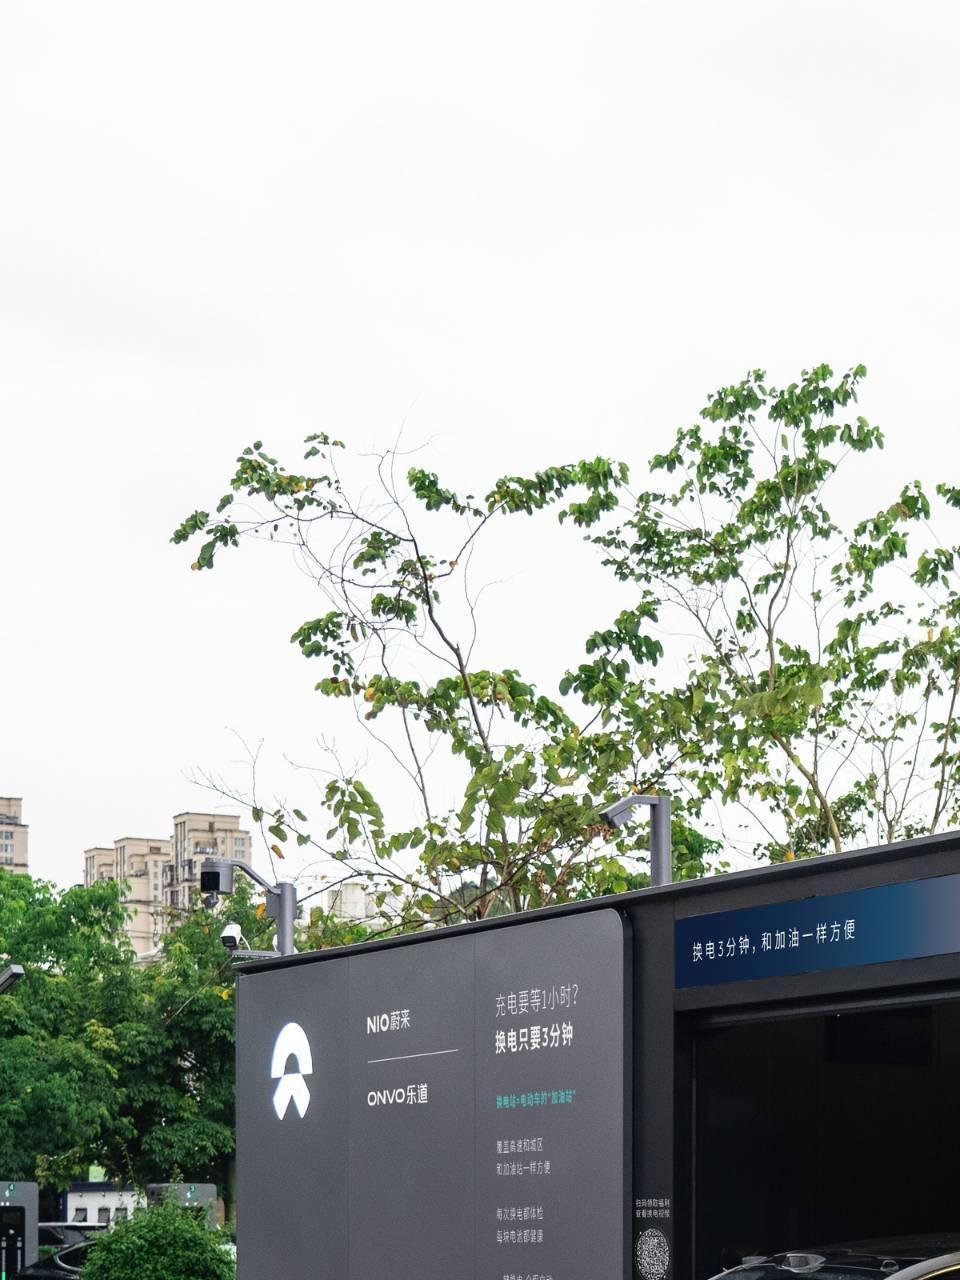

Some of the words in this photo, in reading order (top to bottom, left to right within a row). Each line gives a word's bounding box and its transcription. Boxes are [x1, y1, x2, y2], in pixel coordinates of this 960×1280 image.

[495, 1021, 574, 1054] 换电只要3分钟
